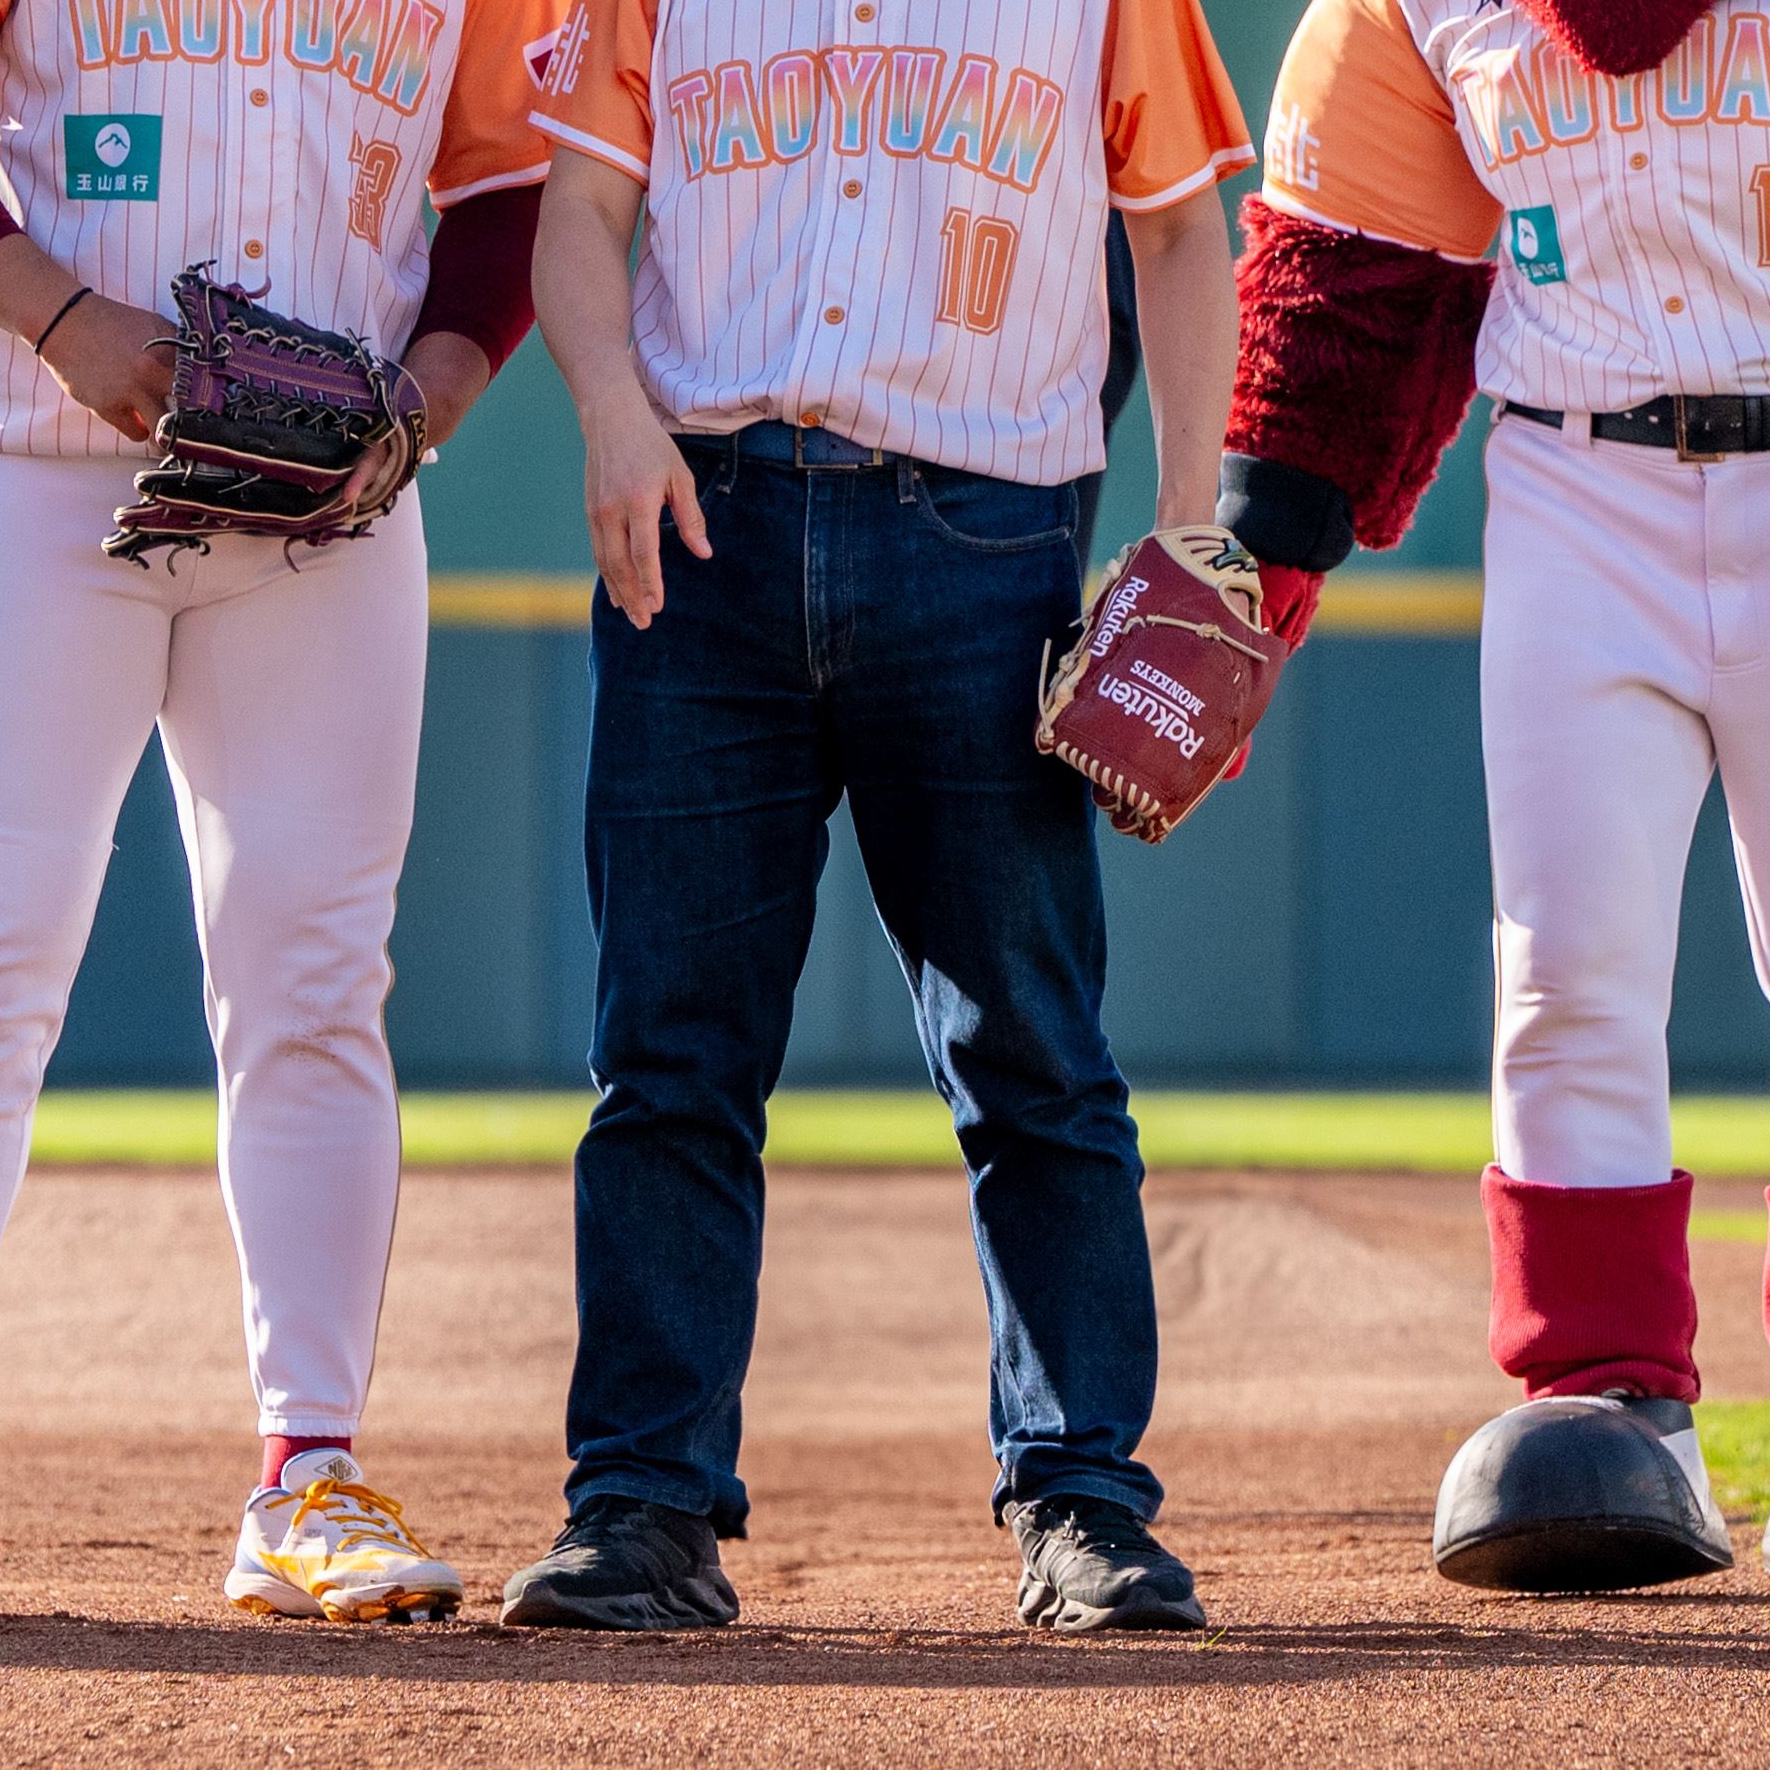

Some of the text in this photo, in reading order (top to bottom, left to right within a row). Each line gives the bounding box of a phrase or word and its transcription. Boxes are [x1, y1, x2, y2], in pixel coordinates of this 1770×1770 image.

[668, 45, 1063, 194] TAOYUAN
[76, 173, 149, 192] 玉山銀行
[936, 206, 1019, 336] 10
[1089, 575, 1150, 658] Rakuten
[1097, 673, 1206, 760] Rakuten
[1130, 659, 1207, 717] MONKEYS
